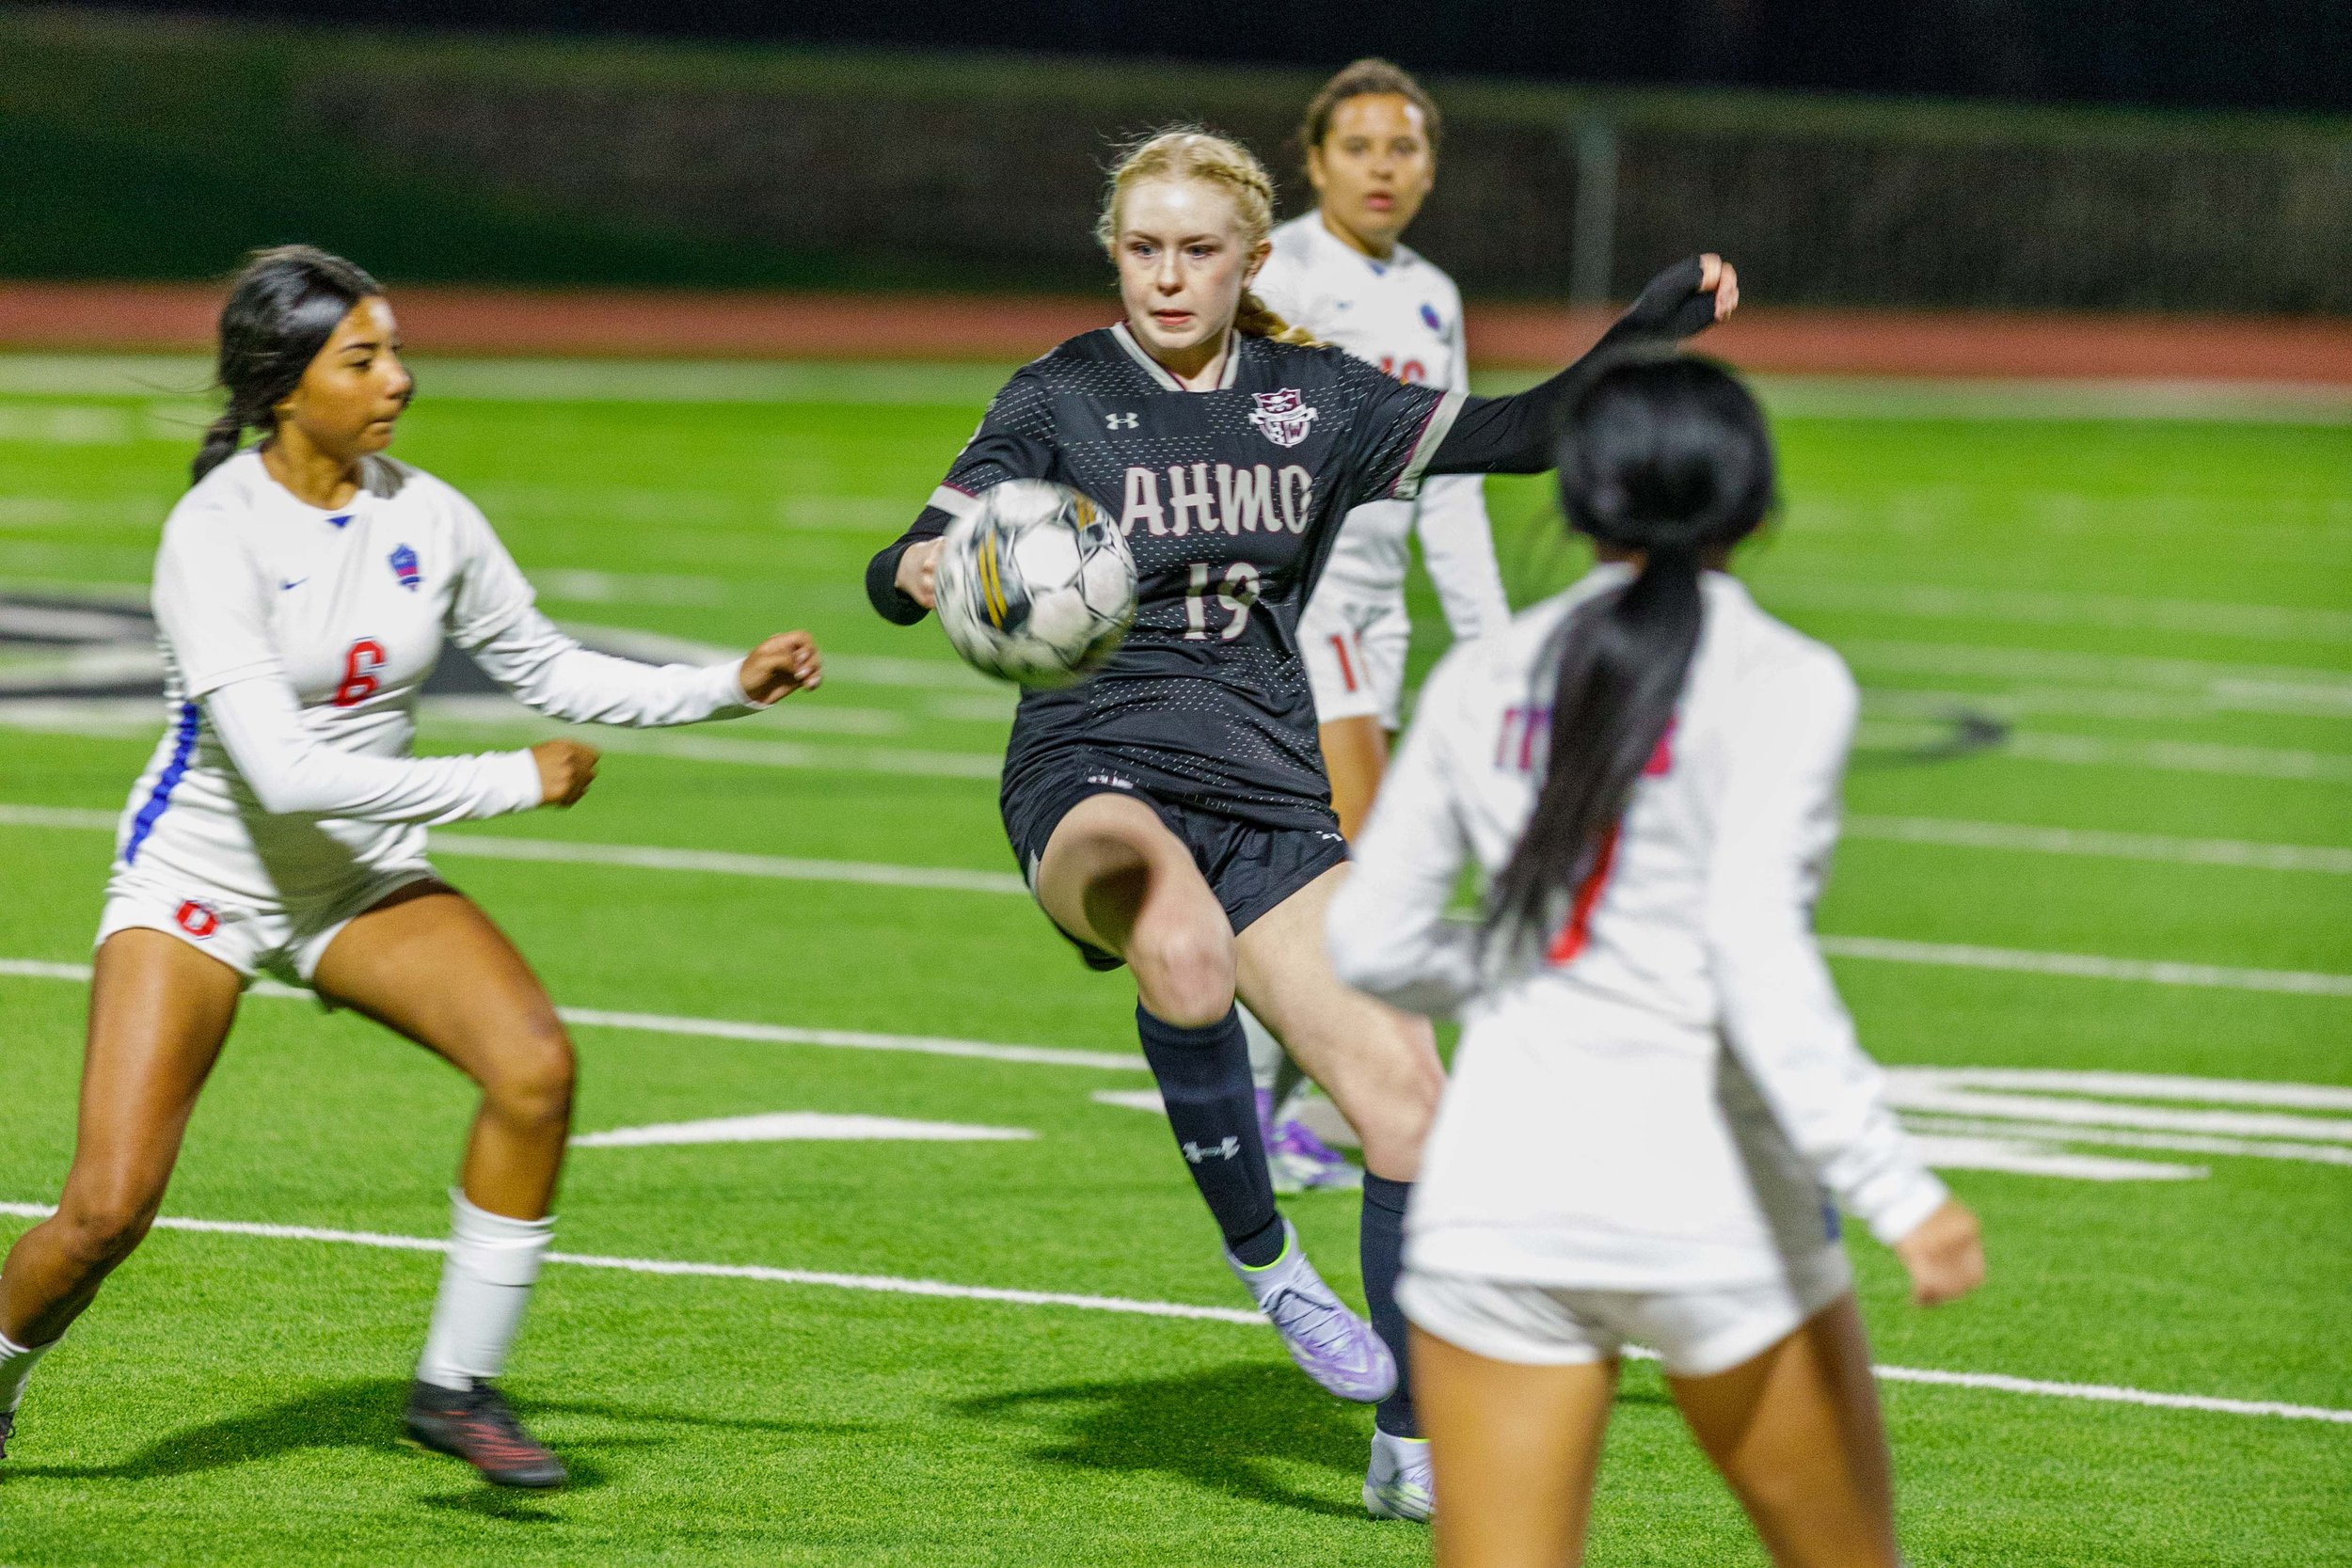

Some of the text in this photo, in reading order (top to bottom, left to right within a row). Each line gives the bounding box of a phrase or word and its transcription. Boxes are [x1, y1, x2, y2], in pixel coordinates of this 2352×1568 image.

[1120, 463, 1312, 536] AHMO
[1184, 562, 1261, 641] 19
[333, 636, 387, 710] 6
